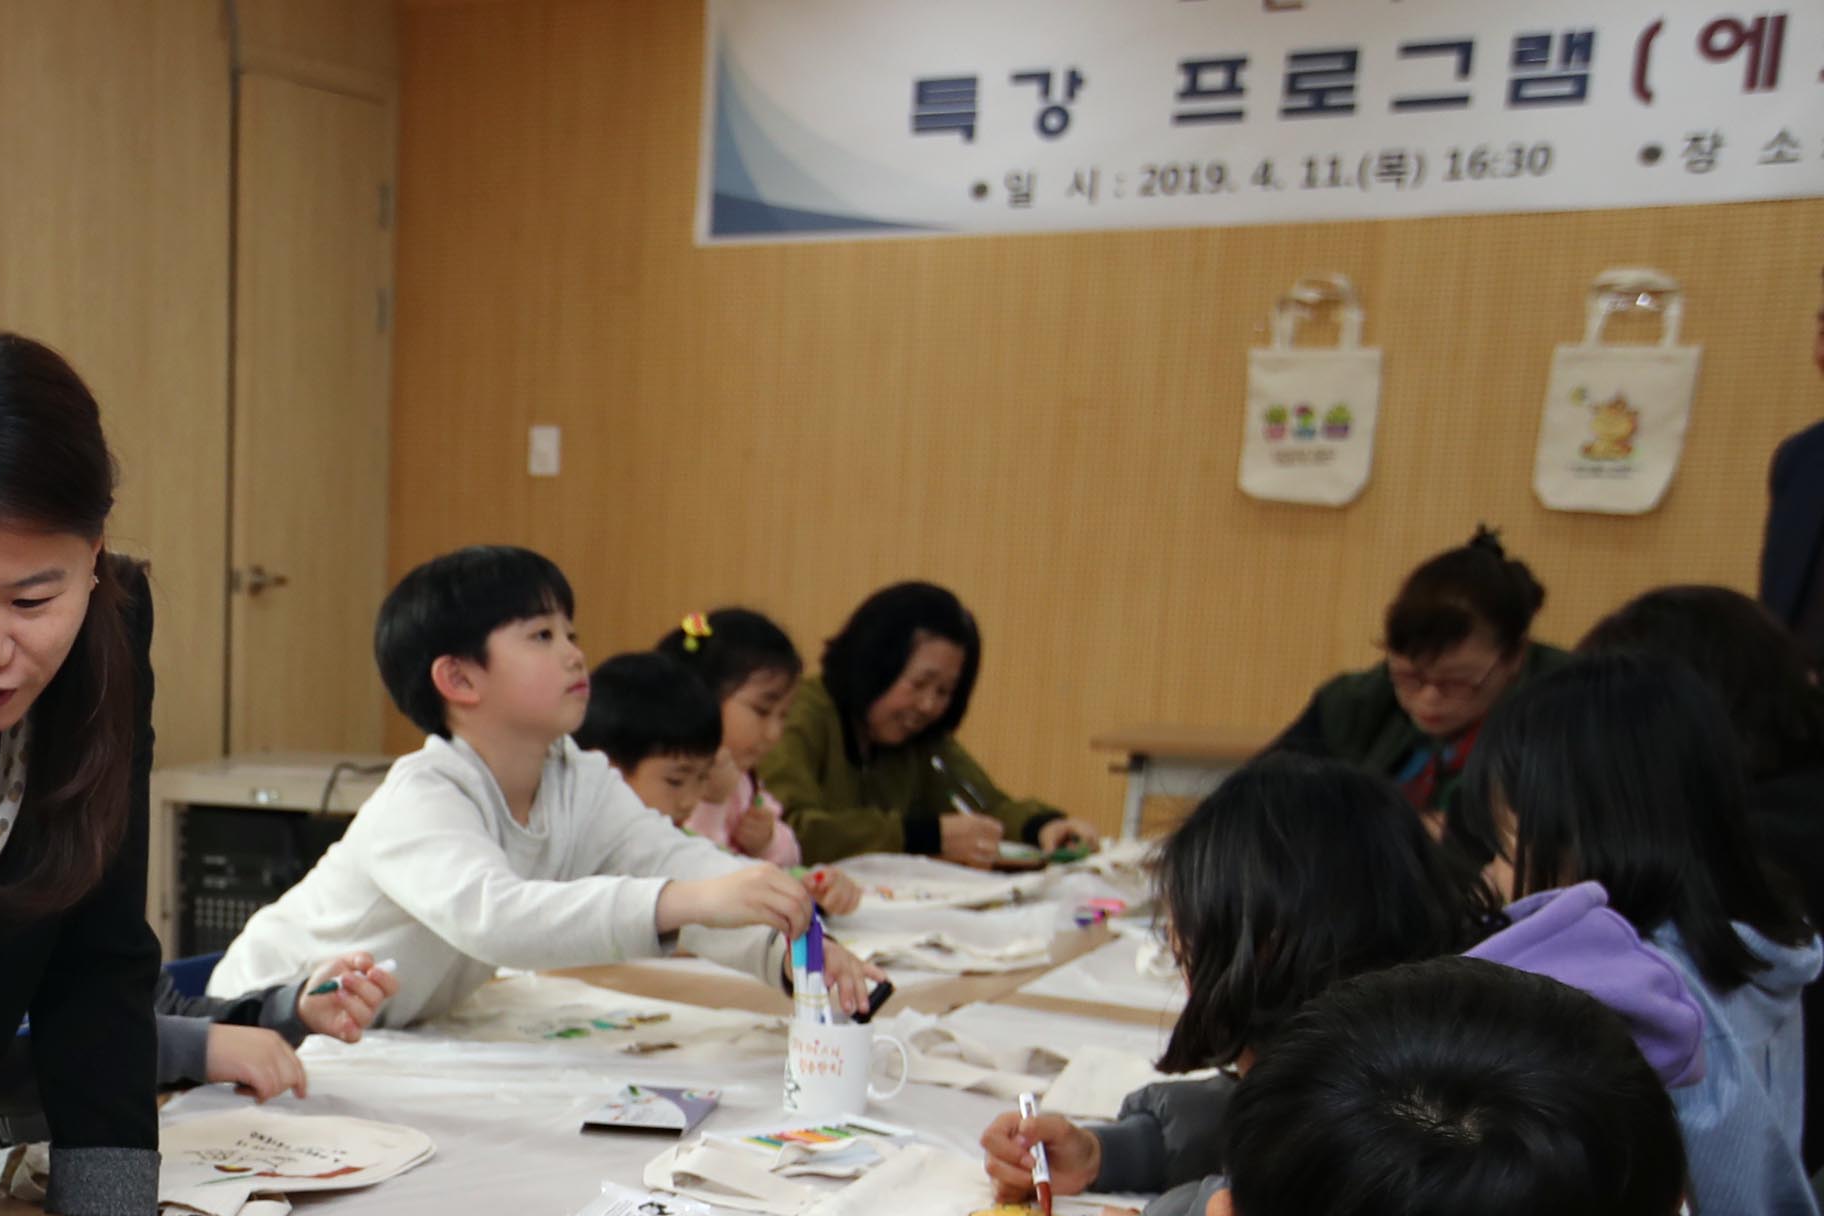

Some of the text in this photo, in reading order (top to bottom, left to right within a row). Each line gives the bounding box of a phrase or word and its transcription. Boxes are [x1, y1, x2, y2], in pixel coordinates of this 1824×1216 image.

[1171, 30, 1596, 127] 프로그램
[1632, 14, 1824, 105] (에
[1442, 143, 1554, 182] 16:30
